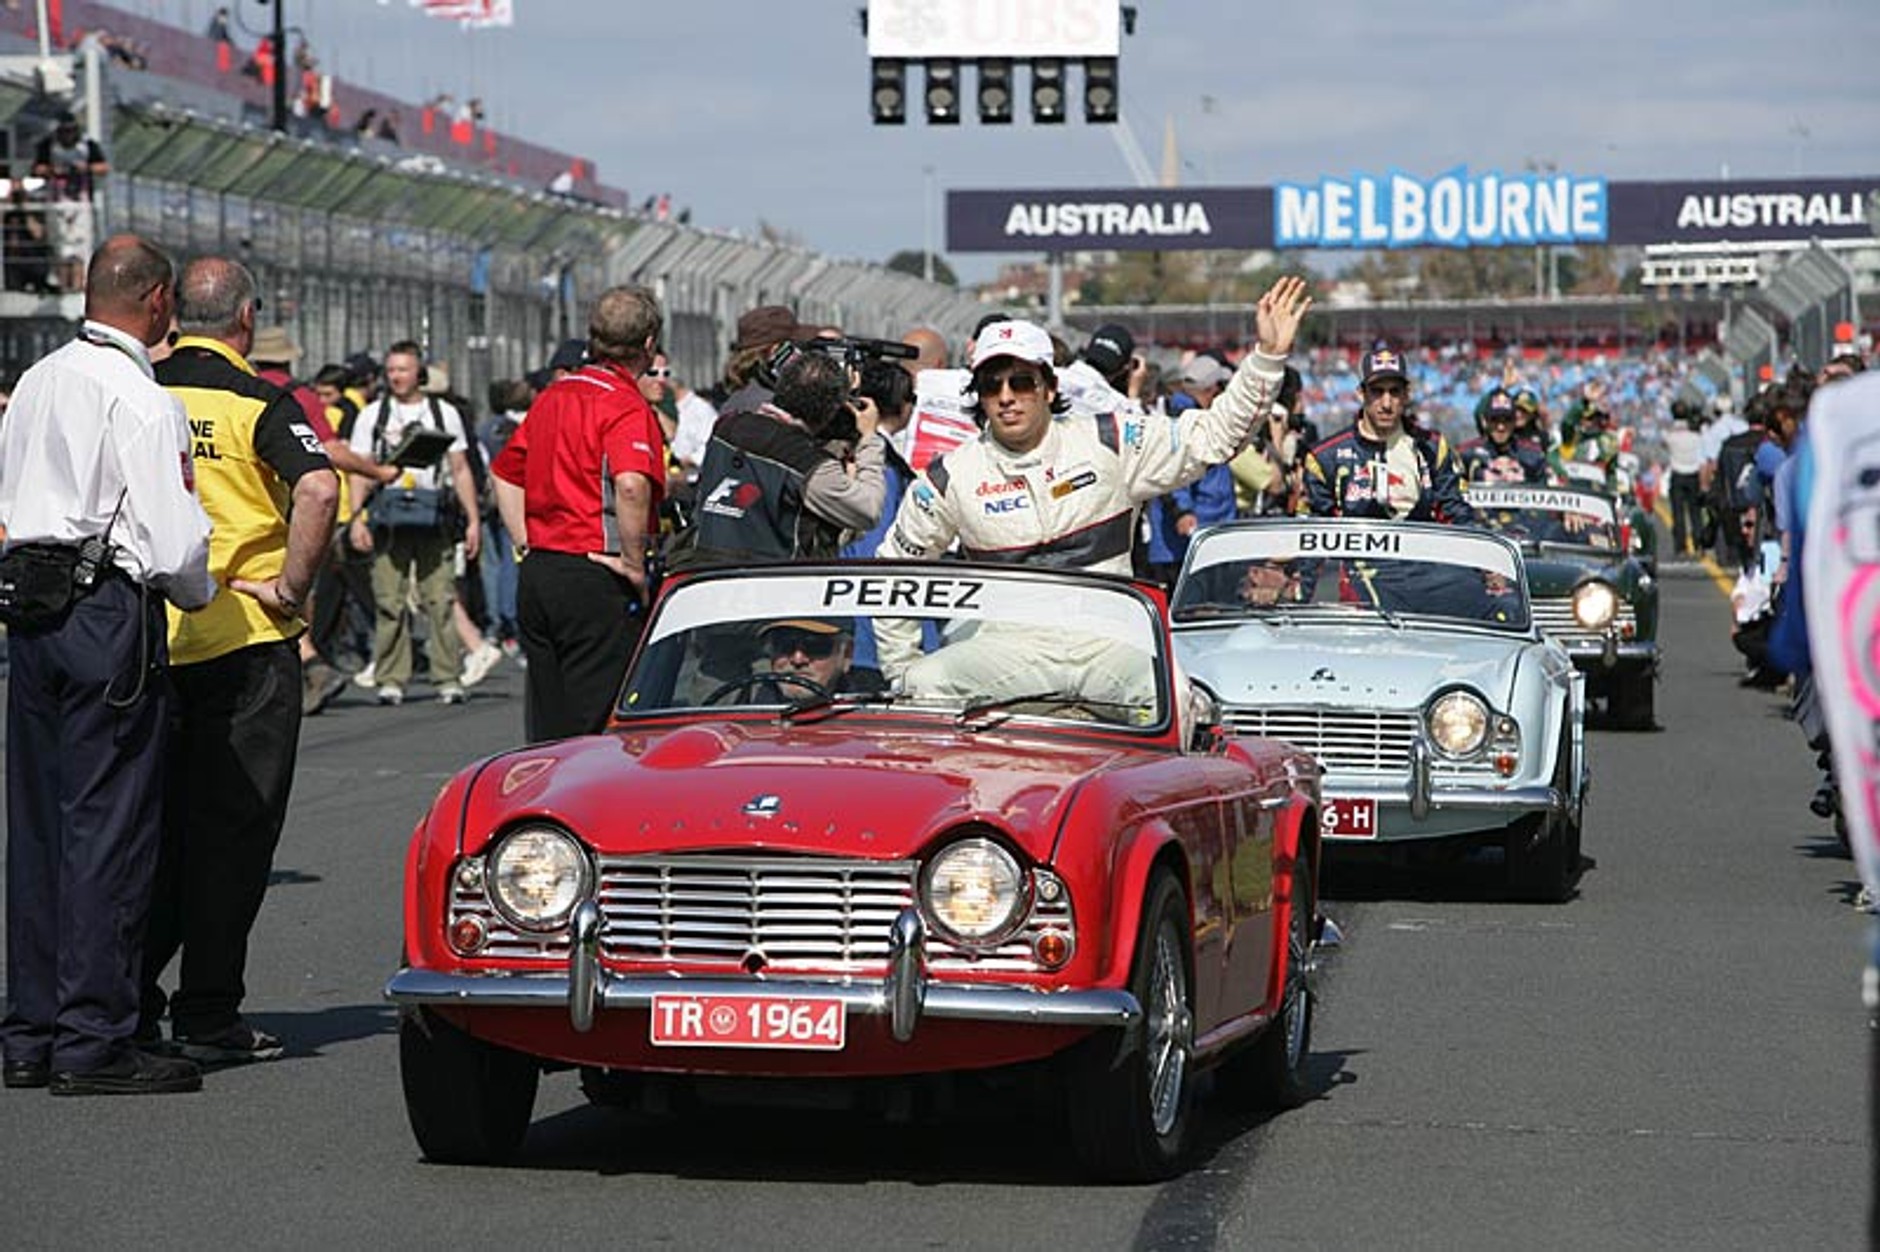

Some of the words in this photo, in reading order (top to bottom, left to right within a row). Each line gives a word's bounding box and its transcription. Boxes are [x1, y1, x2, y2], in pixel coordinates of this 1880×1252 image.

[1004, 202, 1210, 235] AUSTRALIA
[1279, 174, 1601, 241] MELBOURNE
[1677, 192, 1865, 228] AUSTRALI
[984, 496, 1030, 515] NEC
[1299, 532, 1400, 553] BUEMI
[822, 579, 984, 610] PEREZ
[657, 1001, 704, 1037] TR
[747, 1002, 839, 1041] 1964
